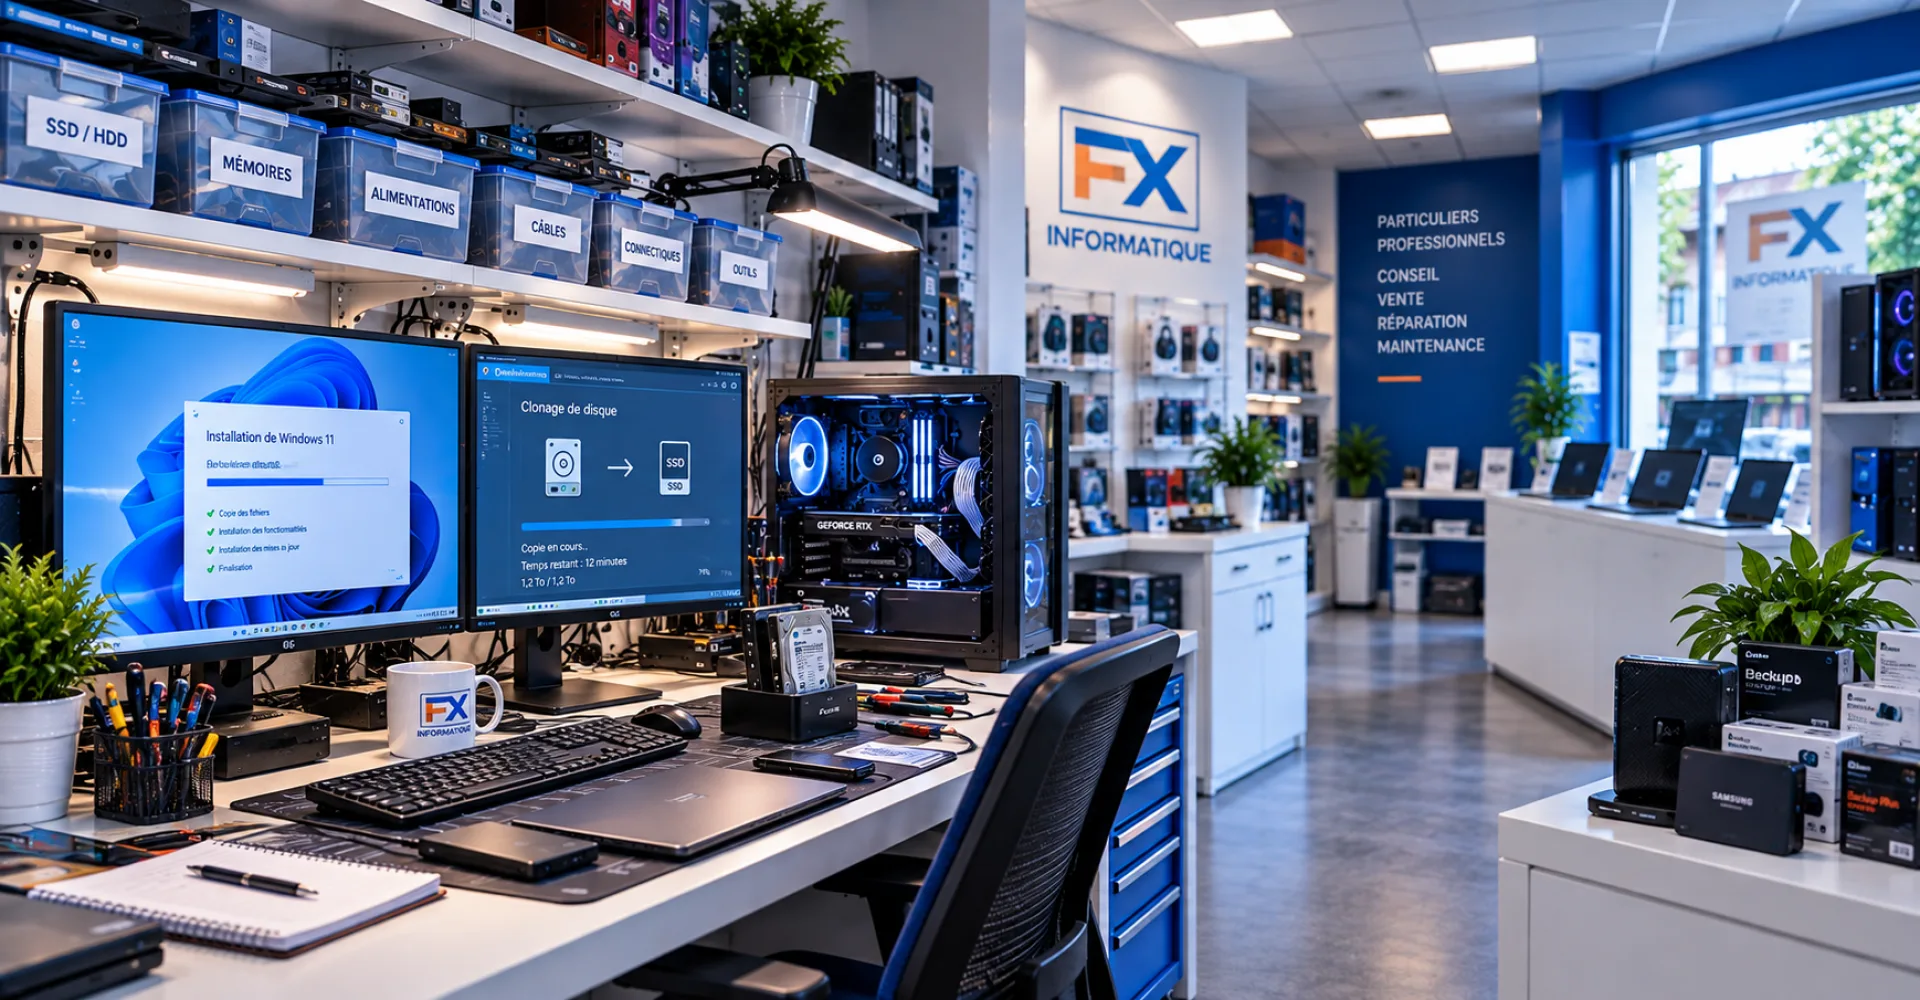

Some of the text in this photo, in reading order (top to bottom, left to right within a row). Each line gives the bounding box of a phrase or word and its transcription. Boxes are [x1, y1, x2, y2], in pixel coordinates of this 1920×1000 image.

[46, 116, 128, 149] SSD / HDD
[222, 151, 292, 183] MÉMOIRES
[1074, 126, 1189, 214] FX
[370, 186, 456, 217] ALIMENTATIONS
[1377, 209, 1480, 229] PARTICULIERS
[1748, 201, 1844, 263] FX
[1047, 224, 1212, 264] INFORMATIQUE
[1377, 231, 1506, 252] PROFESSIONNELS
[624, 240, 682, 264] CONNECTIQUES
[732, 263, 758, 280] OUTILS
[1377, 267, 1440, 283] CONSEIL
[1377, 291, 1425, 307] VENTE
[1377, 313, 1468, 330] RÉPARATION
[1377, 337, 1486, 354] MAINTENANCE
[520, 400, 618, 419] Clonage de disque
[206, 430, 334, 445] Installation de Windows 11
[666, 456, 685, 469] SSD
[667, 481, 683, 492] SSD
[237, 509, 248, 517] des
[817, 521, 873, 531] GEFORCE RTX
[521, 542, 546, 555] Copie
[547, 542, 559, 552] en
[521, 560, 548, 573] Temps
[550, 558, 579, 569] restant
[586, 558, 595, 568] 12
[596, 556, 628, 567] minutes
[521, 578, 534, 588] 1,2
[535, 577, 546, 587] To
[552, 576, 565, 587] 1,2
[566, 575, 576, 585] To
[426, 693, 468, 723] FX
[1712, 791, 1753, 806] SAMSUNG
